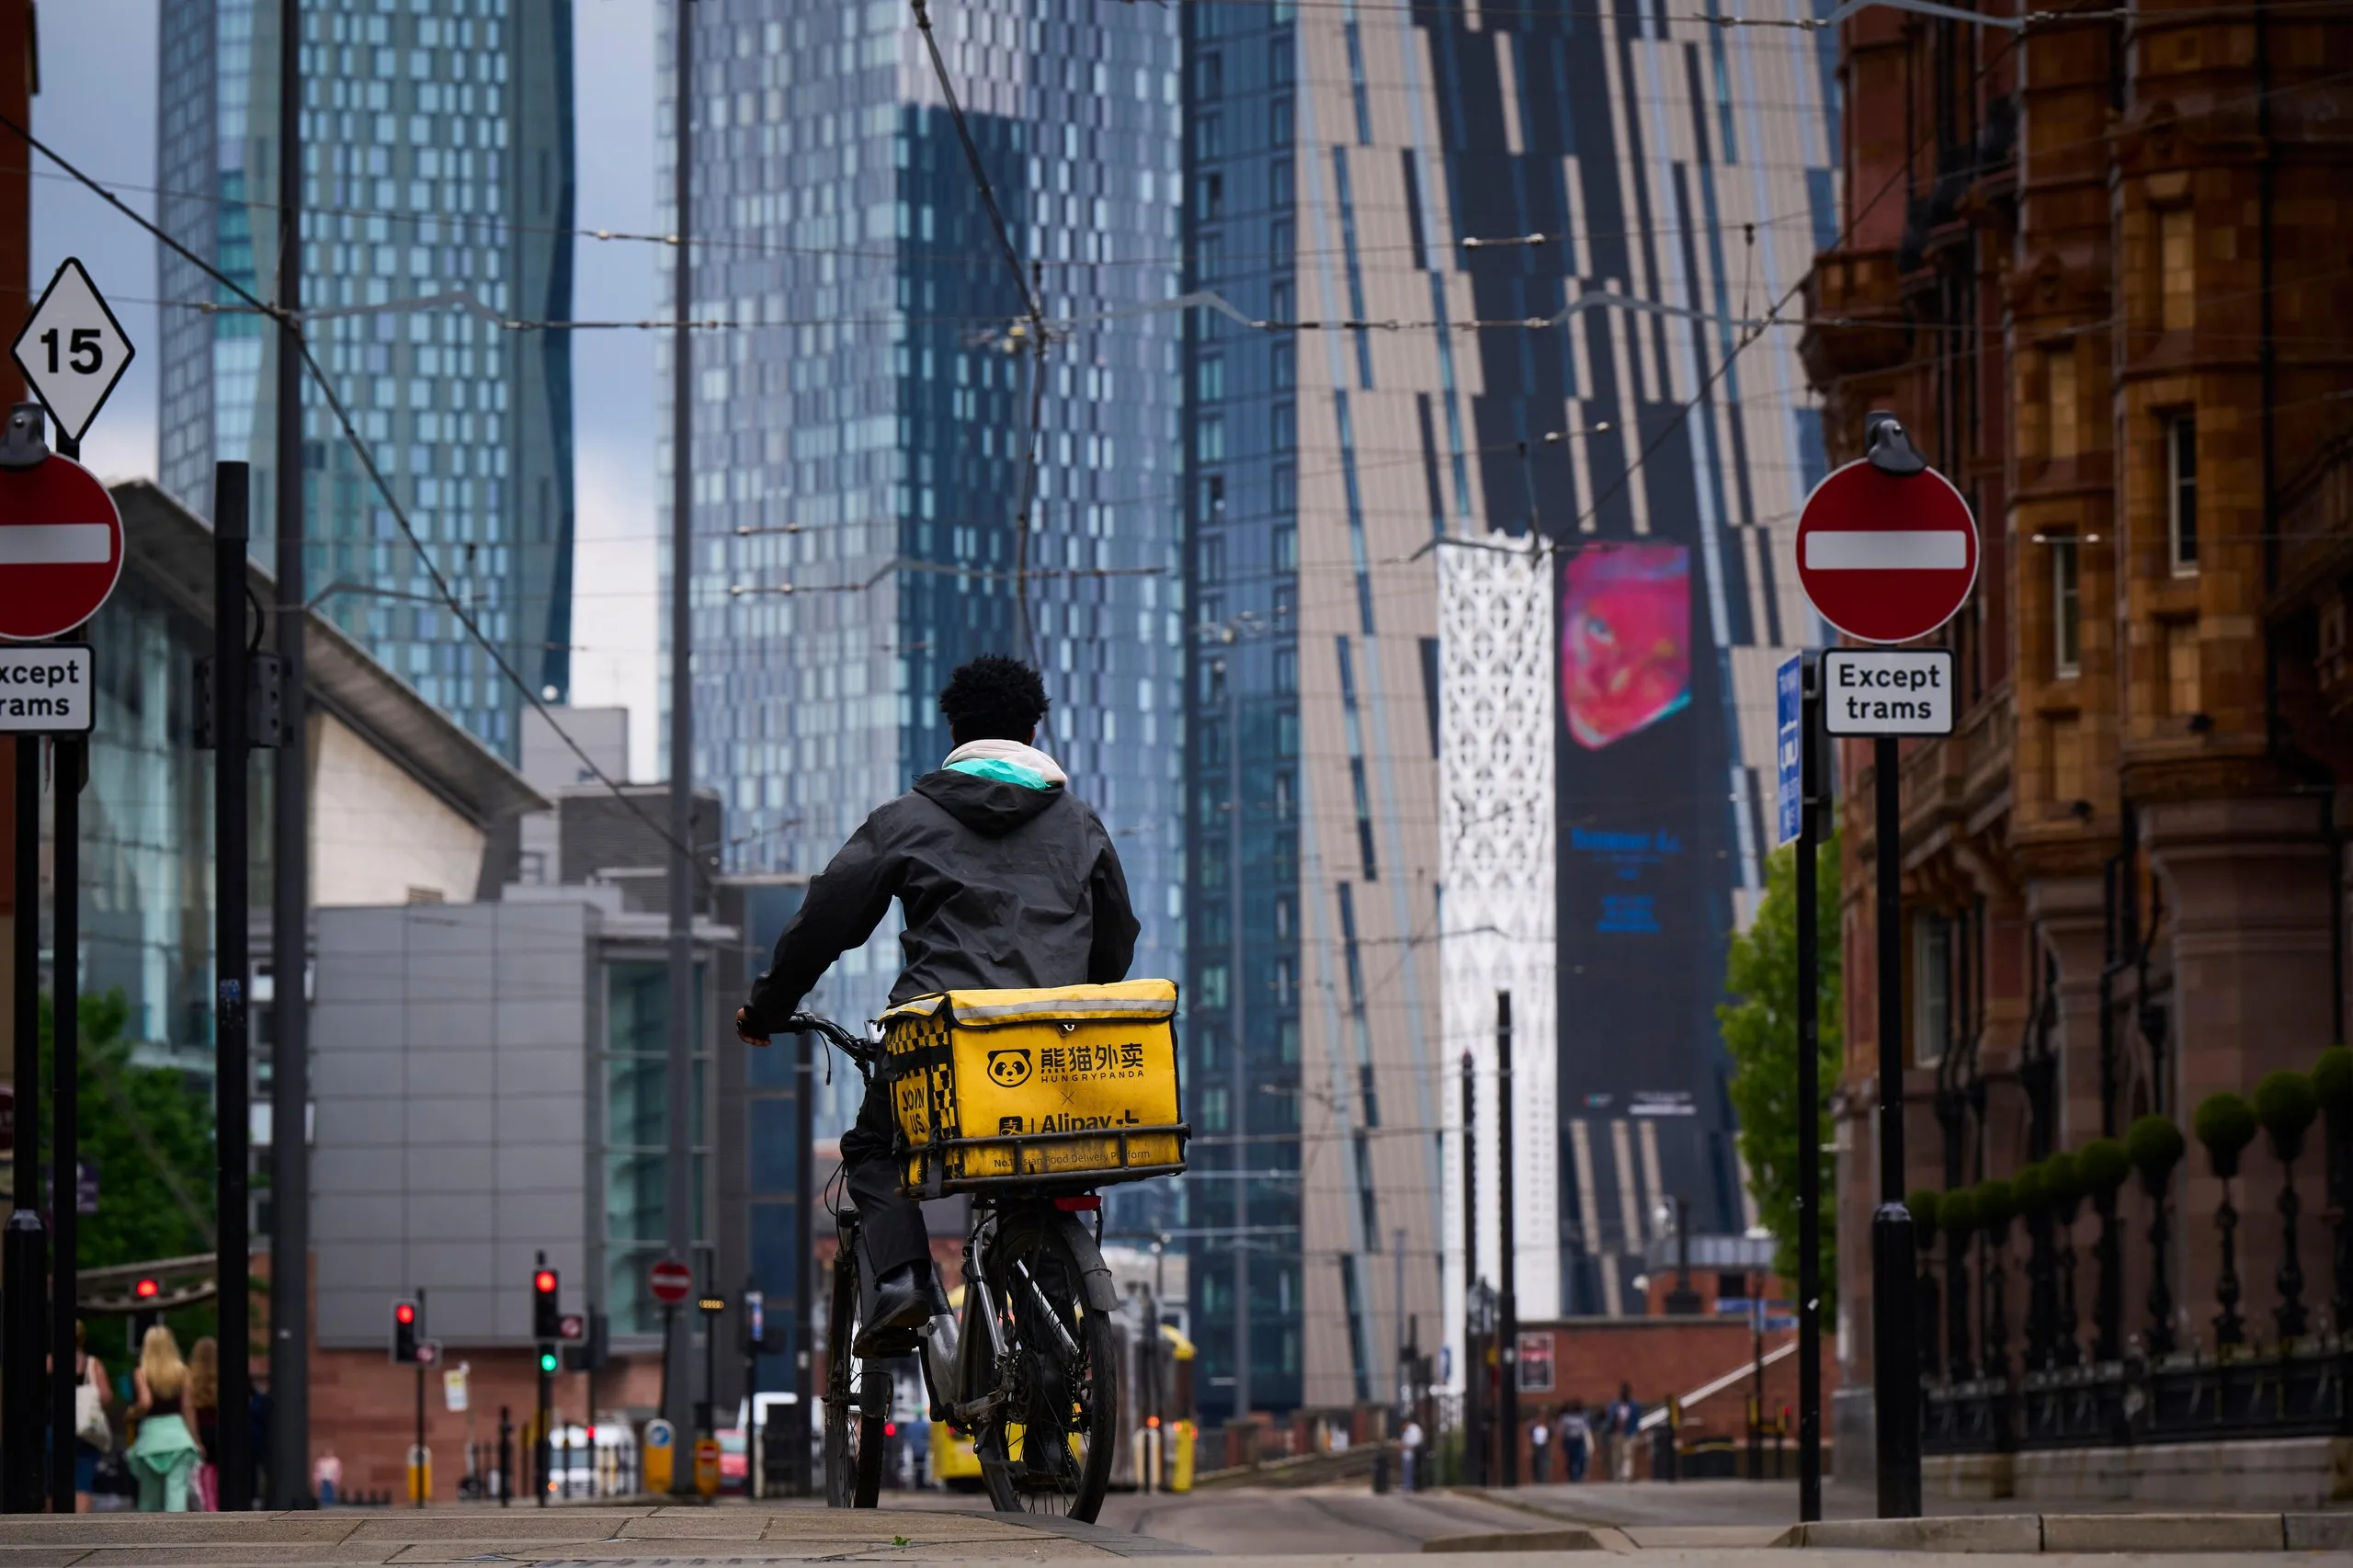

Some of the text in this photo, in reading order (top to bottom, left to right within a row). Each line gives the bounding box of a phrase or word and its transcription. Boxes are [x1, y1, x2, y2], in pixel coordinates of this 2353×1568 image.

[40, 328, 103, 375] 15
[0, 659, 79, 688] xcept
[1839, 664, 1940, 692] Except
[0, 698, 70, 716] rams
[1846, 696, 1932, 720] trams
[1040, 1043, 1144, 1074] 熊猫外卖
[1040, 1070, 1144, 1084] HUNGRYPANDA
[903, 1087, 925, 1112] JOIN
[909, 1112, 926, 1136] US
[1021, 1156, 1042, 1167] sian
[1071, 1152, 1108, 1164] Delivery
[1110, 1150, 1150, 1160] Plform
